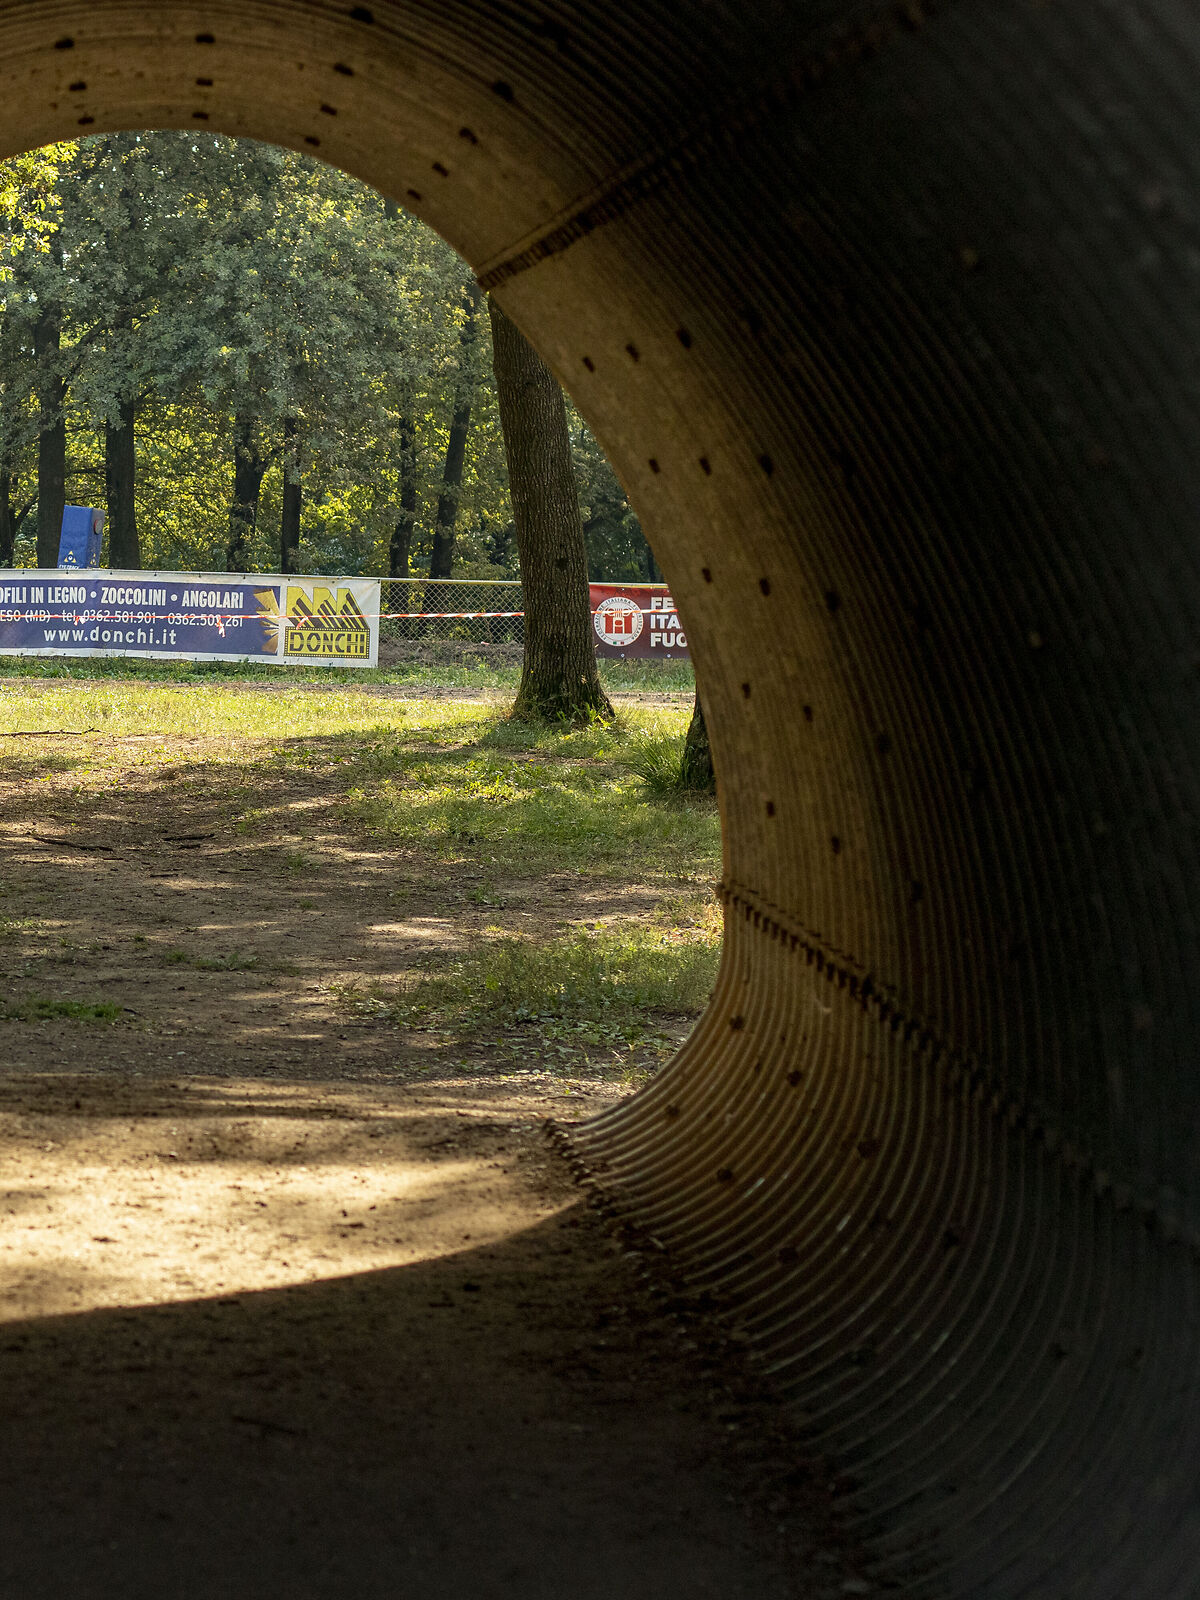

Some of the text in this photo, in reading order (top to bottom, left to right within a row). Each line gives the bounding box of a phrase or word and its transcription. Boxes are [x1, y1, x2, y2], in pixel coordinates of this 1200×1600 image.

[31, 587, 44, 604] IN
[48, 587, 87, 604] LEGNO
[101, 587, 166, 606] ZOCCOLINI
[181, 589, 244, 609] ANGOLARI
[25, 609, 51, 623] (MB)
[61, 609, 79, 622] tel
[83, 609, 156, 624] 0362.501.901
[650, 614, 683, 629] ITA
[43, 626, 177, 645] www.donchi.it
[290, 632, 365, 654] DONCHI
